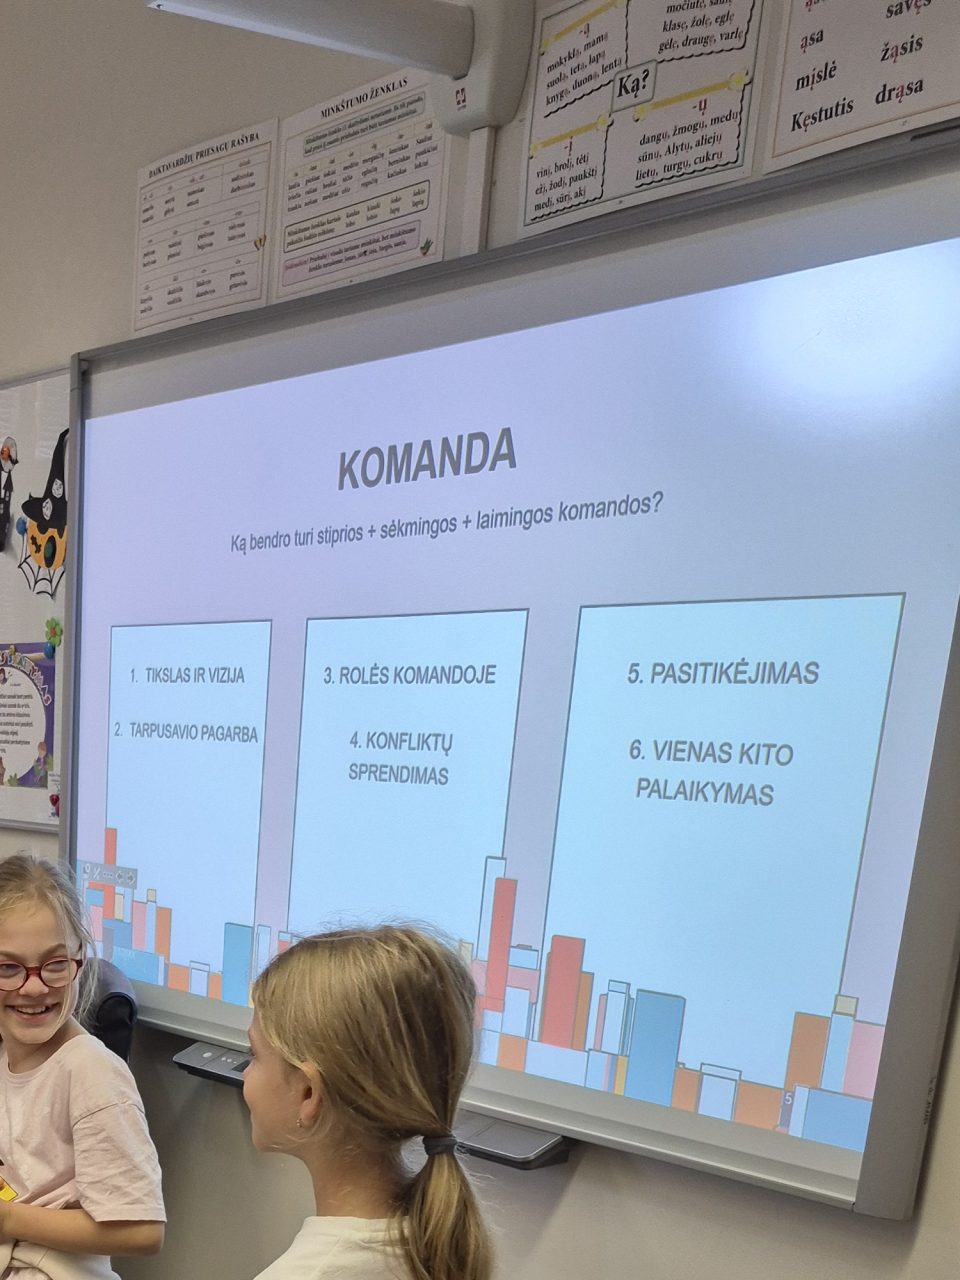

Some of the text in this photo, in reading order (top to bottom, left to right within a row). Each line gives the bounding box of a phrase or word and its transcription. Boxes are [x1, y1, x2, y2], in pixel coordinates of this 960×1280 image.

[800, 29, 824, 53] ąsa
[881, 34, 923, 63] žąsis
[369, 77, 408, 100] ŽENKLAS
[617, 68, 650, 98] Ką?
[795, 60, 837, 91] mįslė
[875, 79, 924, 104] drąsa
[791, 97, 854, 132] Kęstutis
[338, 427, 517, 491] KOMANDA
[230, 490, 664, 556] Ką bendro turi stiprios + sėkmingos + laimingos komandos?
[130, 667, 245, 683] 1. TIKSLAS IR VIZIJA
[324, 662, 497, 684] 3. ROLĖS KOMANDOJE
[628, 657, 820, 684] 5. PASITIKĖJIMAS
[114, 721, 258, 743] 2. TARPUSAVIO PAGARBA
[350, 730, 453, 757] 4. KONFLIKTŲ
[629, 739, 794, 767] 6. VIENAS KITO
[348, 762, 449, 786] SPRENDIMAS
[636, 778, 775, 806] PALAIKYMAS
[784, 1092, 793, 1105] 5
